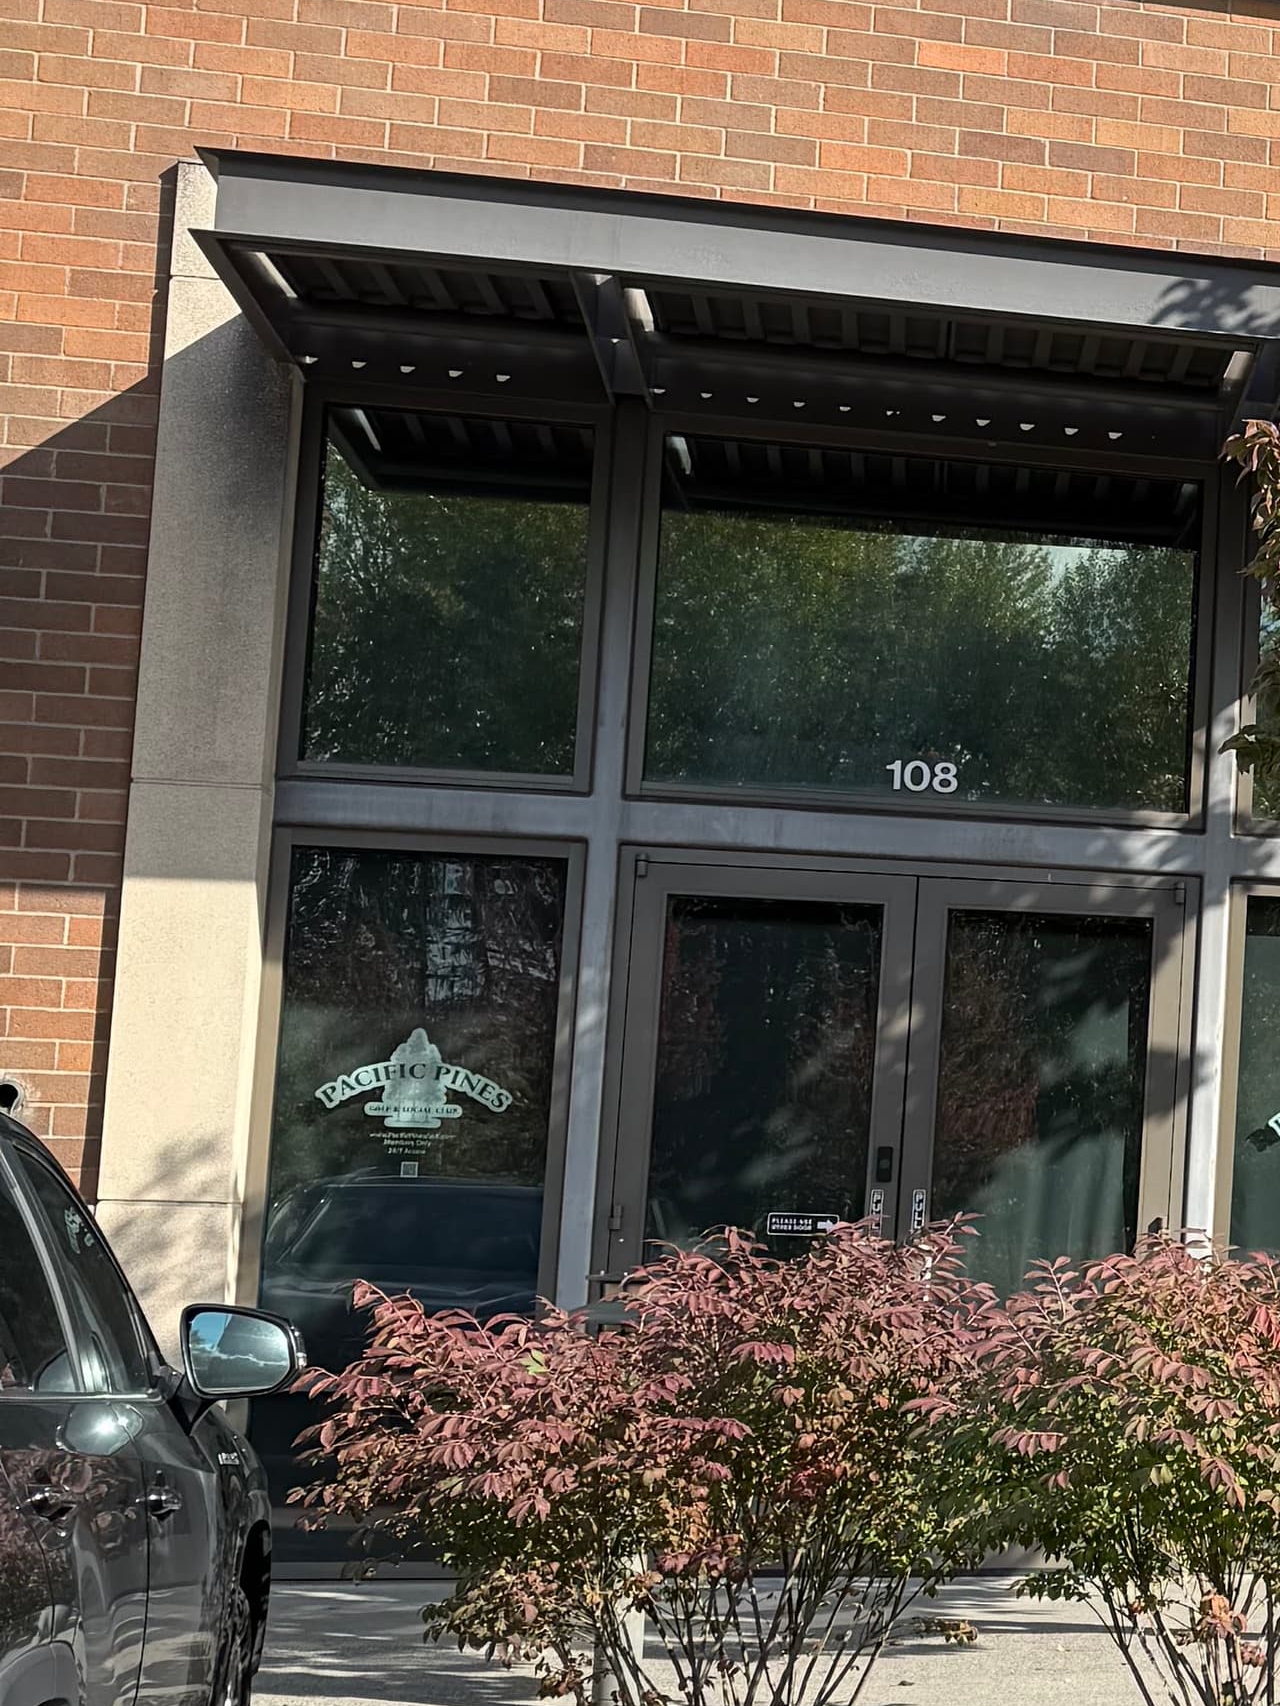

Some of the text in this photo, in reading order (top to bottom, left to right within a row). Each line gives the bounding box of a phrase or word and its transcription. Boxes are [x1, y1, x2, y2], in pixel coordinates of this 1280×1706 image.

[885, 759, 959, 793] 108
[321, 1063, 510, 1109] PACIFIC PINES
[914, 1192, 923, 1229] PULL
